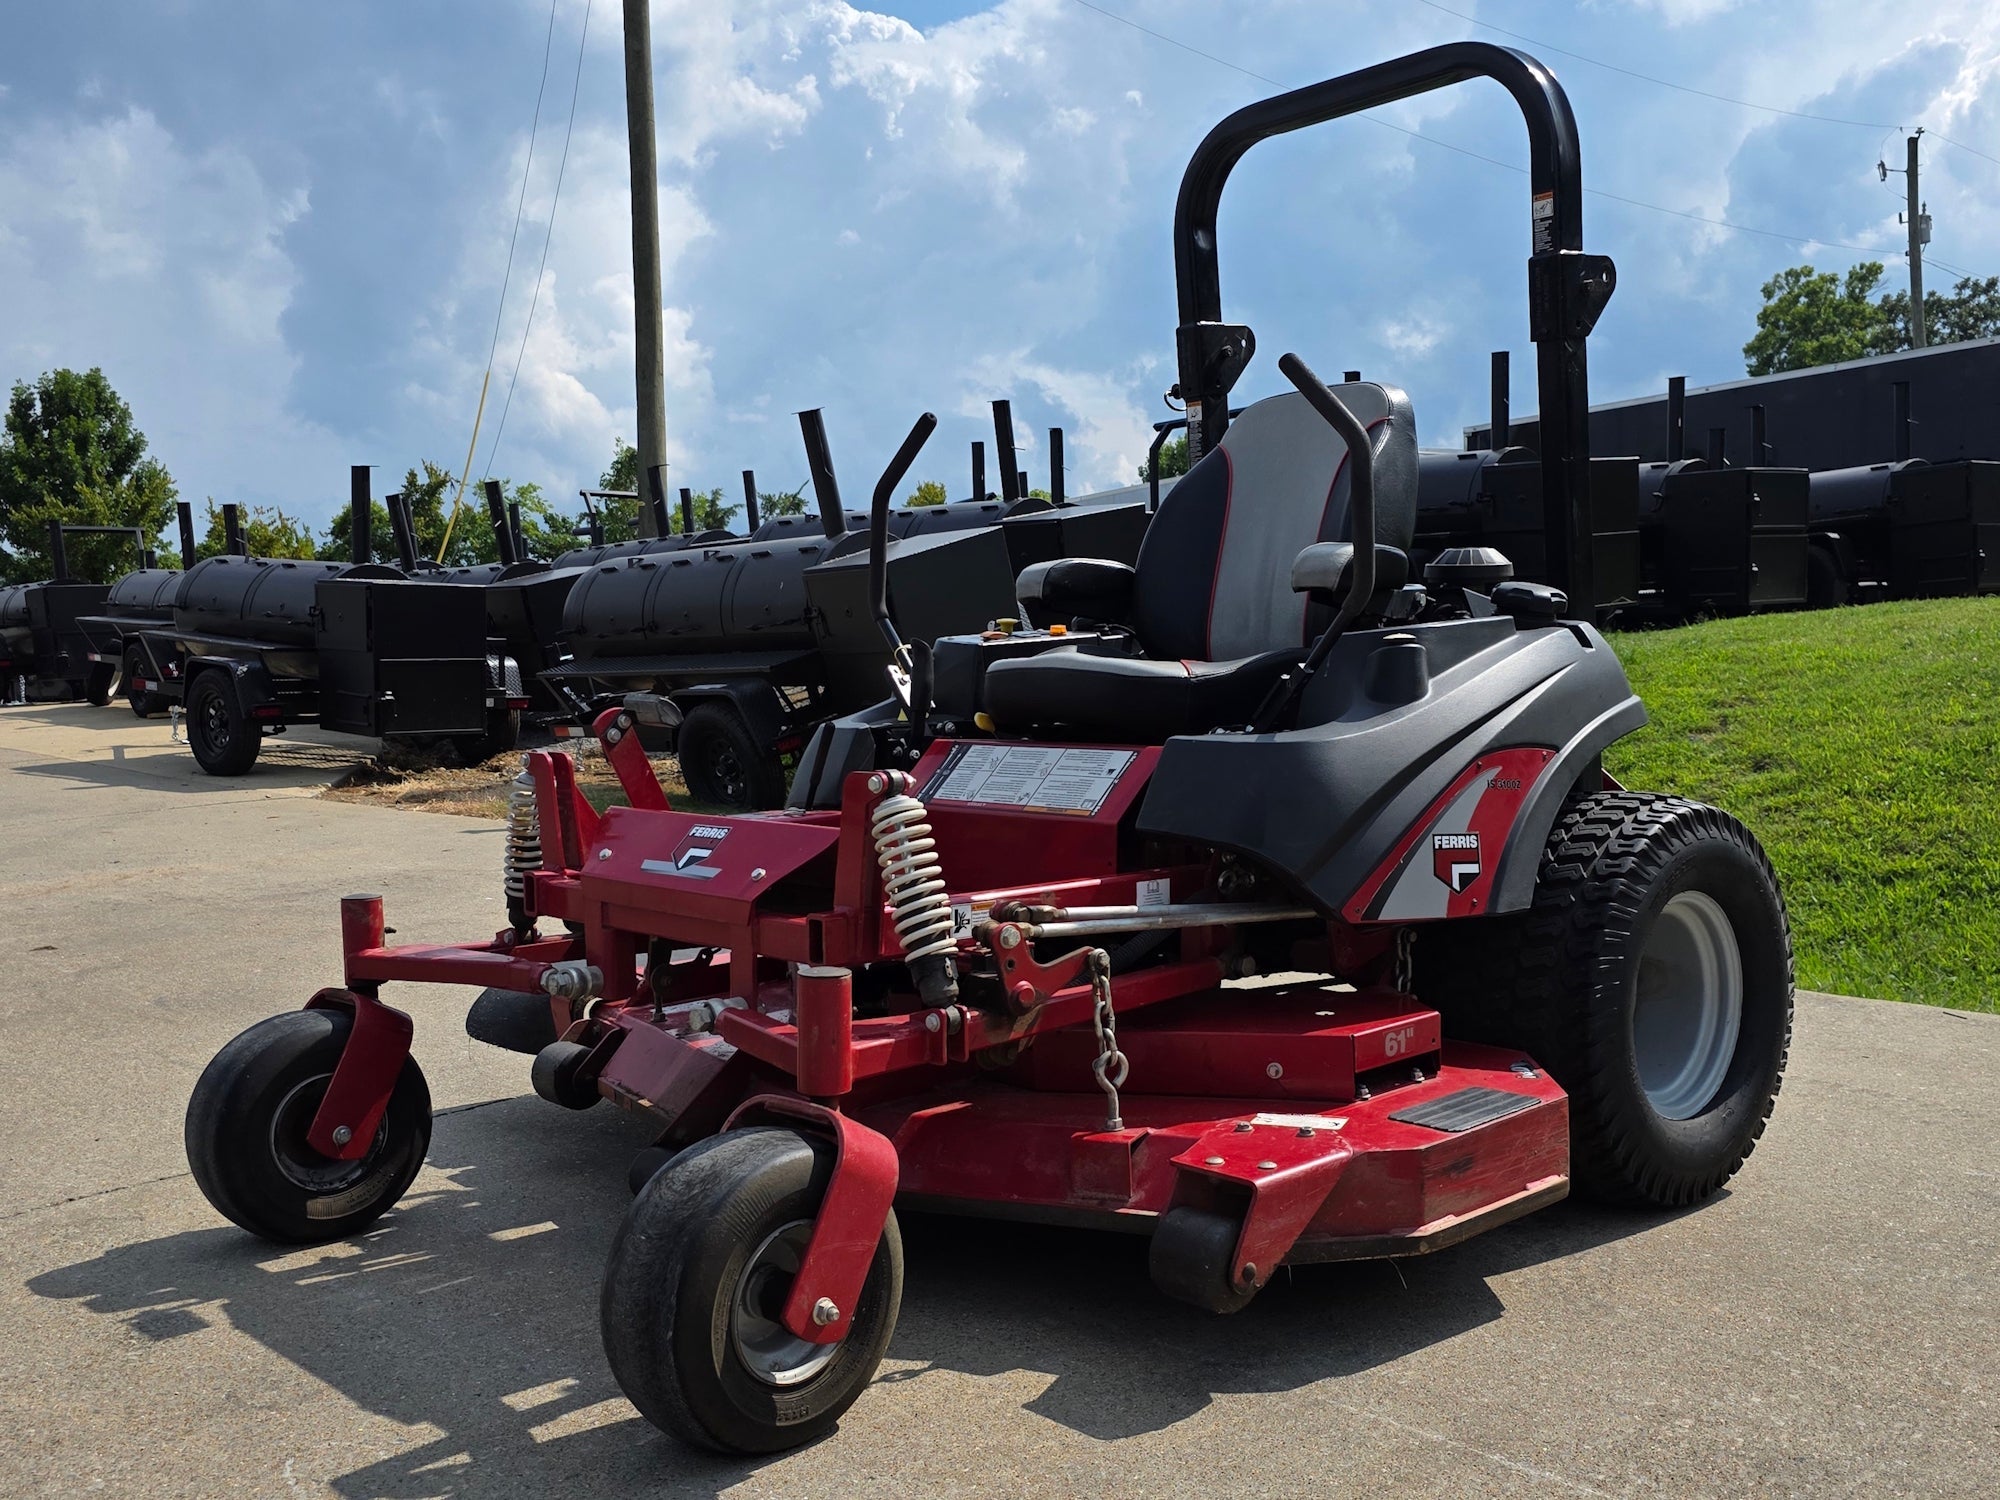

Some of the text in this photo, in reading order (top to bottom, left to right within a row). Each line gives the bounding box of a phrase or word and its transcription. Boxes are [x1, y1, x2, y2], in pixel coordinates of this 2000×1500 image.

[689, 826, 729, 839] FERRIS
[1434, 835, 1478, 849] FERRIS
[1385, 1027, 1414, 1057] 61"
